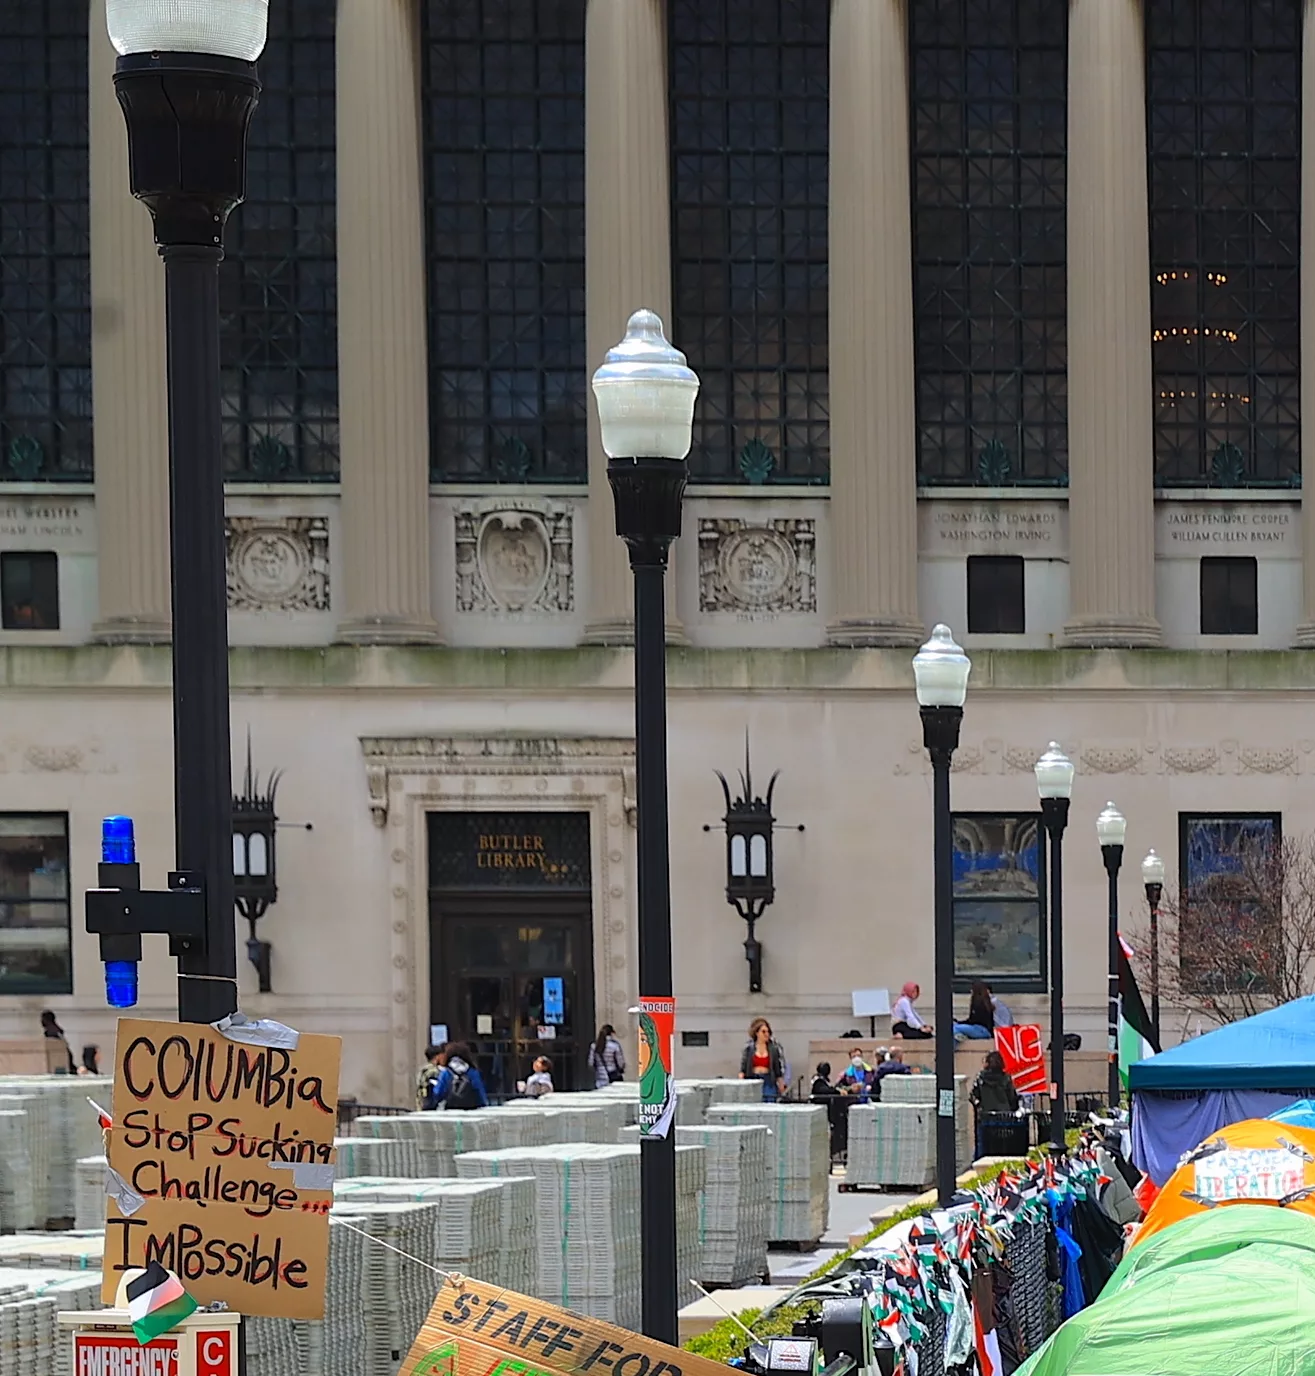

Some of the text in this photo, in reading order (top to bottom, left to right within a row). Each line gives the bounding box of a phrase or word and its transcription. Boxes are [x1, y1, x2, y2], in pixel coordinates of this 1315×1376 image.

[1168, 514, 1199, 524] JAMES
[1253, 514, 1289, 524] COOPER
[1015, 531, 1051, 541] IRVING
[1172, 531, 1285, 542] WILLIAM CULLEN BRYANT
[480, 834, 544, 850] BUTLER
[477, 852, 546, 869] LIBRARY
[212, 1119, 333, 1164] Sucking
[443, 1292, 584, 1359] STAFF
